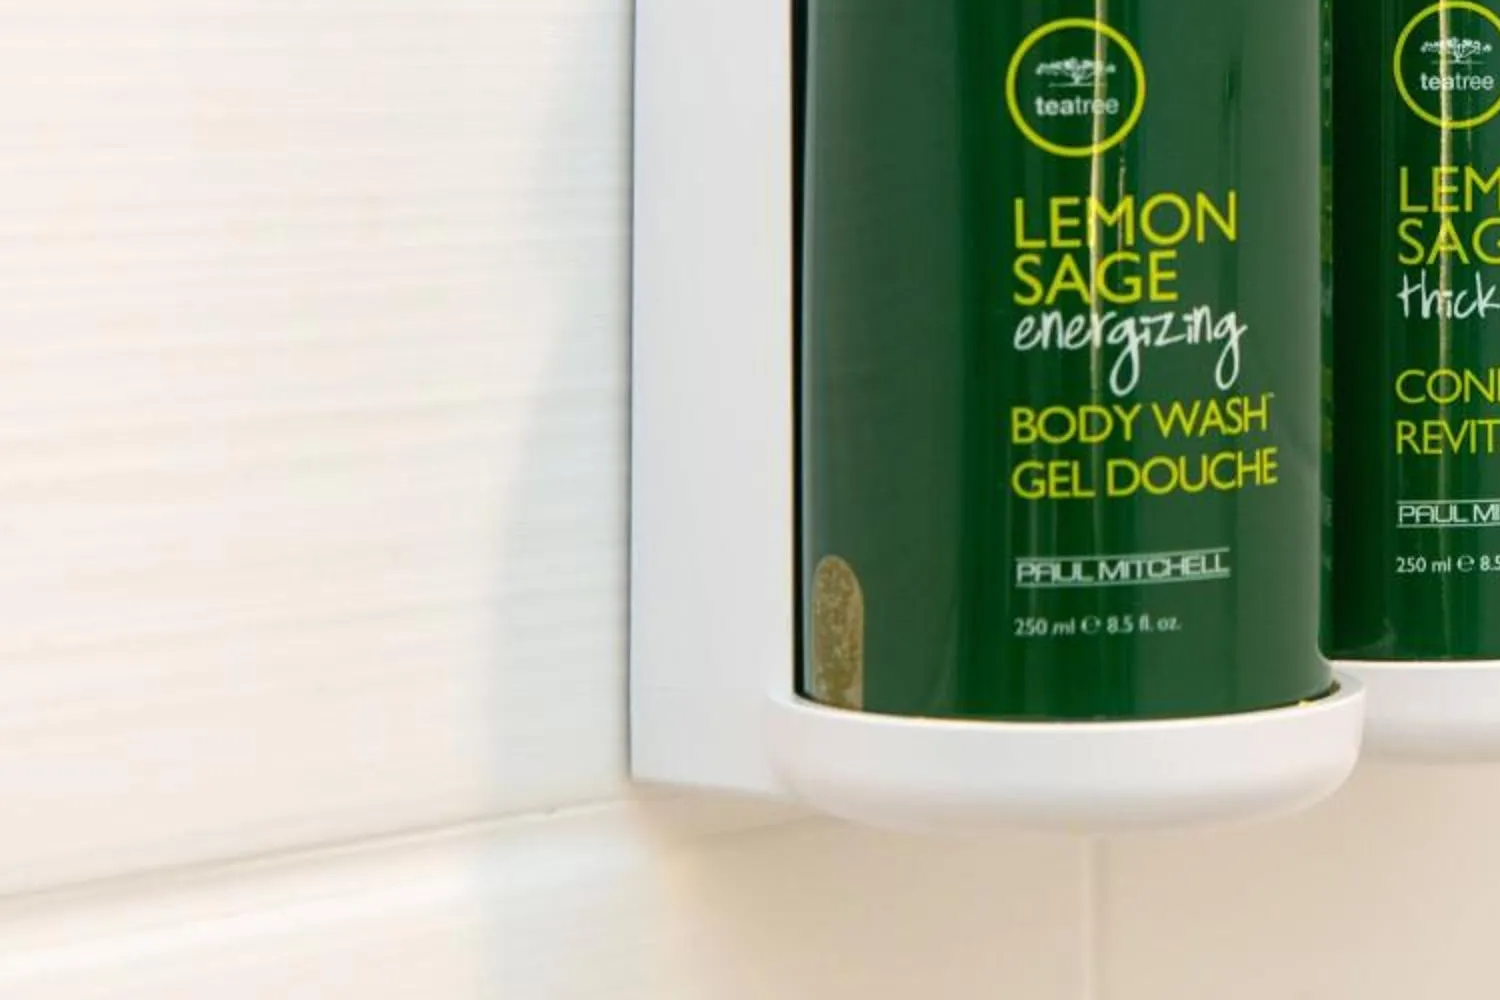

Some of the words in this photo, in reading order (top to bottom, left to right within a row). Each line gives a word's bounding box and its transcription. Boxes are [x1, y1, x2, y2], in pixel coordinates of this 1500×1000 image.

[1420, 73, 1495, 91] teatree
[1035, 96, 1120, 117] teatree
[1014, 189, 1237, 249] LEMON
[1012, 249, 1179, 306] SAGE
[1013, 305, 1247, 396] energizing
[1011, 405, 1142, 444] BODY
[1011, 460, 1096, 499] GEL
[1106, 447, 1279, 497] DOUCHE
[1399, 504, 1469, 524] PAUL
[1016, 561, 1094, 583] PAUL
[1098, 553, 1230, 581] MITCHELL
[1396, 556, 1427, 573] 250
[1431, 556, 1451, 573] ml
[1013, 618, 1048, 636] 250
[1051, 616, 1075, 635] ml
[1106, 613, 1133, 634] 8.5
